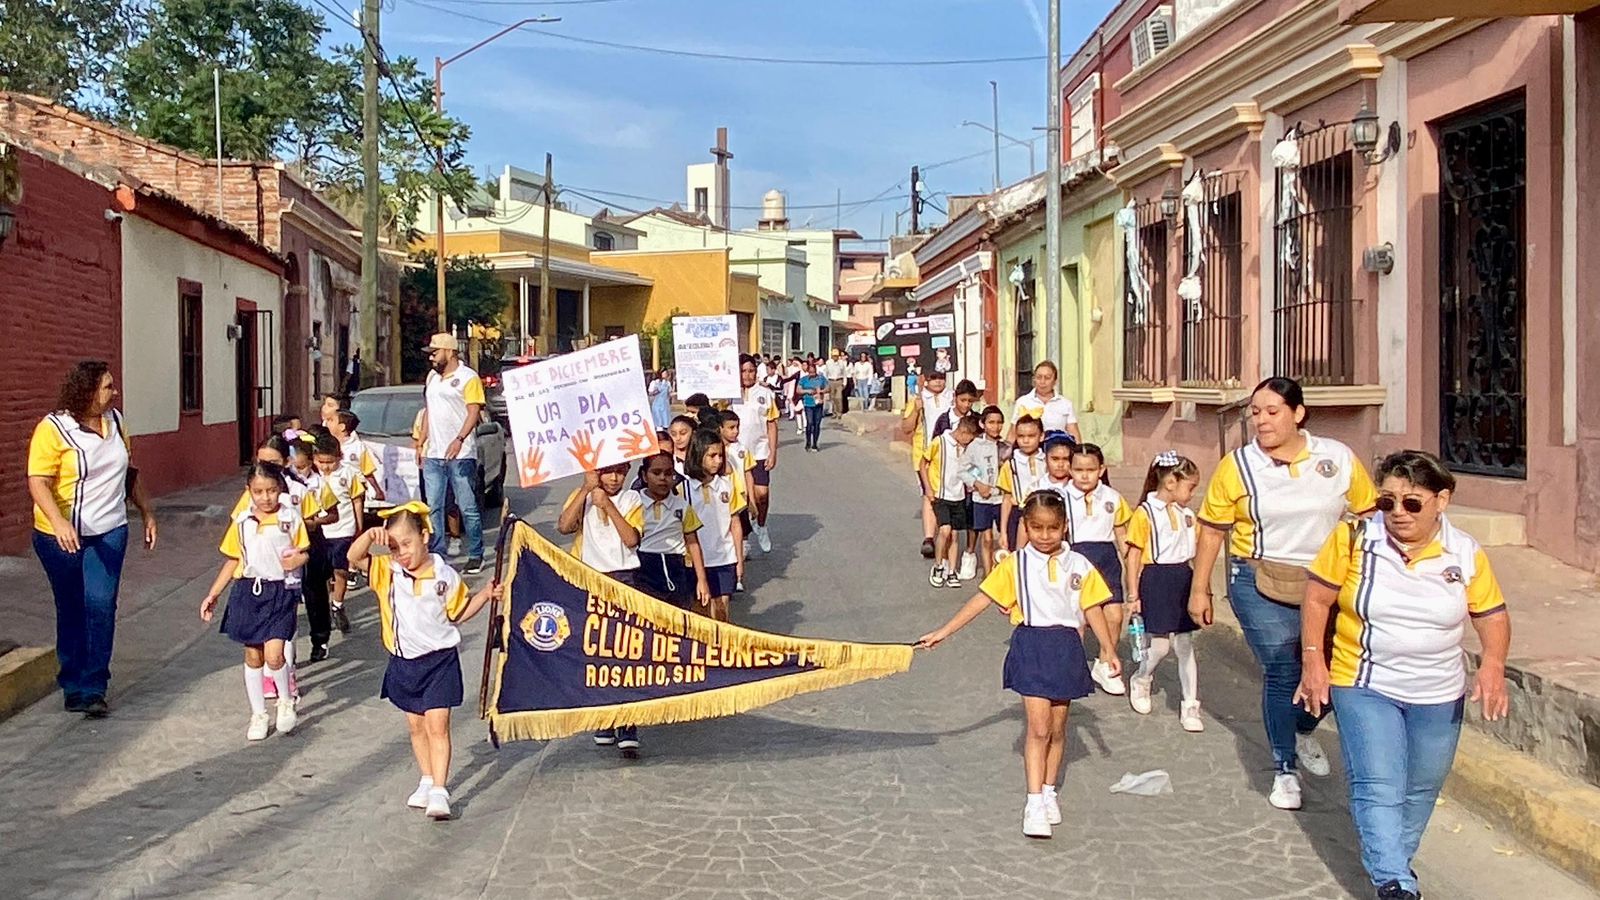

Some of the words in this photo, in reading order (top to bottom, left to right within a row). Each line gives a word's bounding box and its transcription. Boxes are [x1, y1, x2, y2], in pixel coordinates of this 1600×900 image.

[510, 376, 520, 391] 3
[526, 371, 542, 386] DE
[548, 346, 631, 381] DICIEMBRE
[536, 401, 561, 424] UN
[578, 392, 611, 415] DIA
[527, 427, 571, 446] PARA
[584, 410, 641, 435] TODOS
[537, 617, 553, 636] L
[583, 613, 644, 660] CLUB
[652, 631, 681, 663] DE
